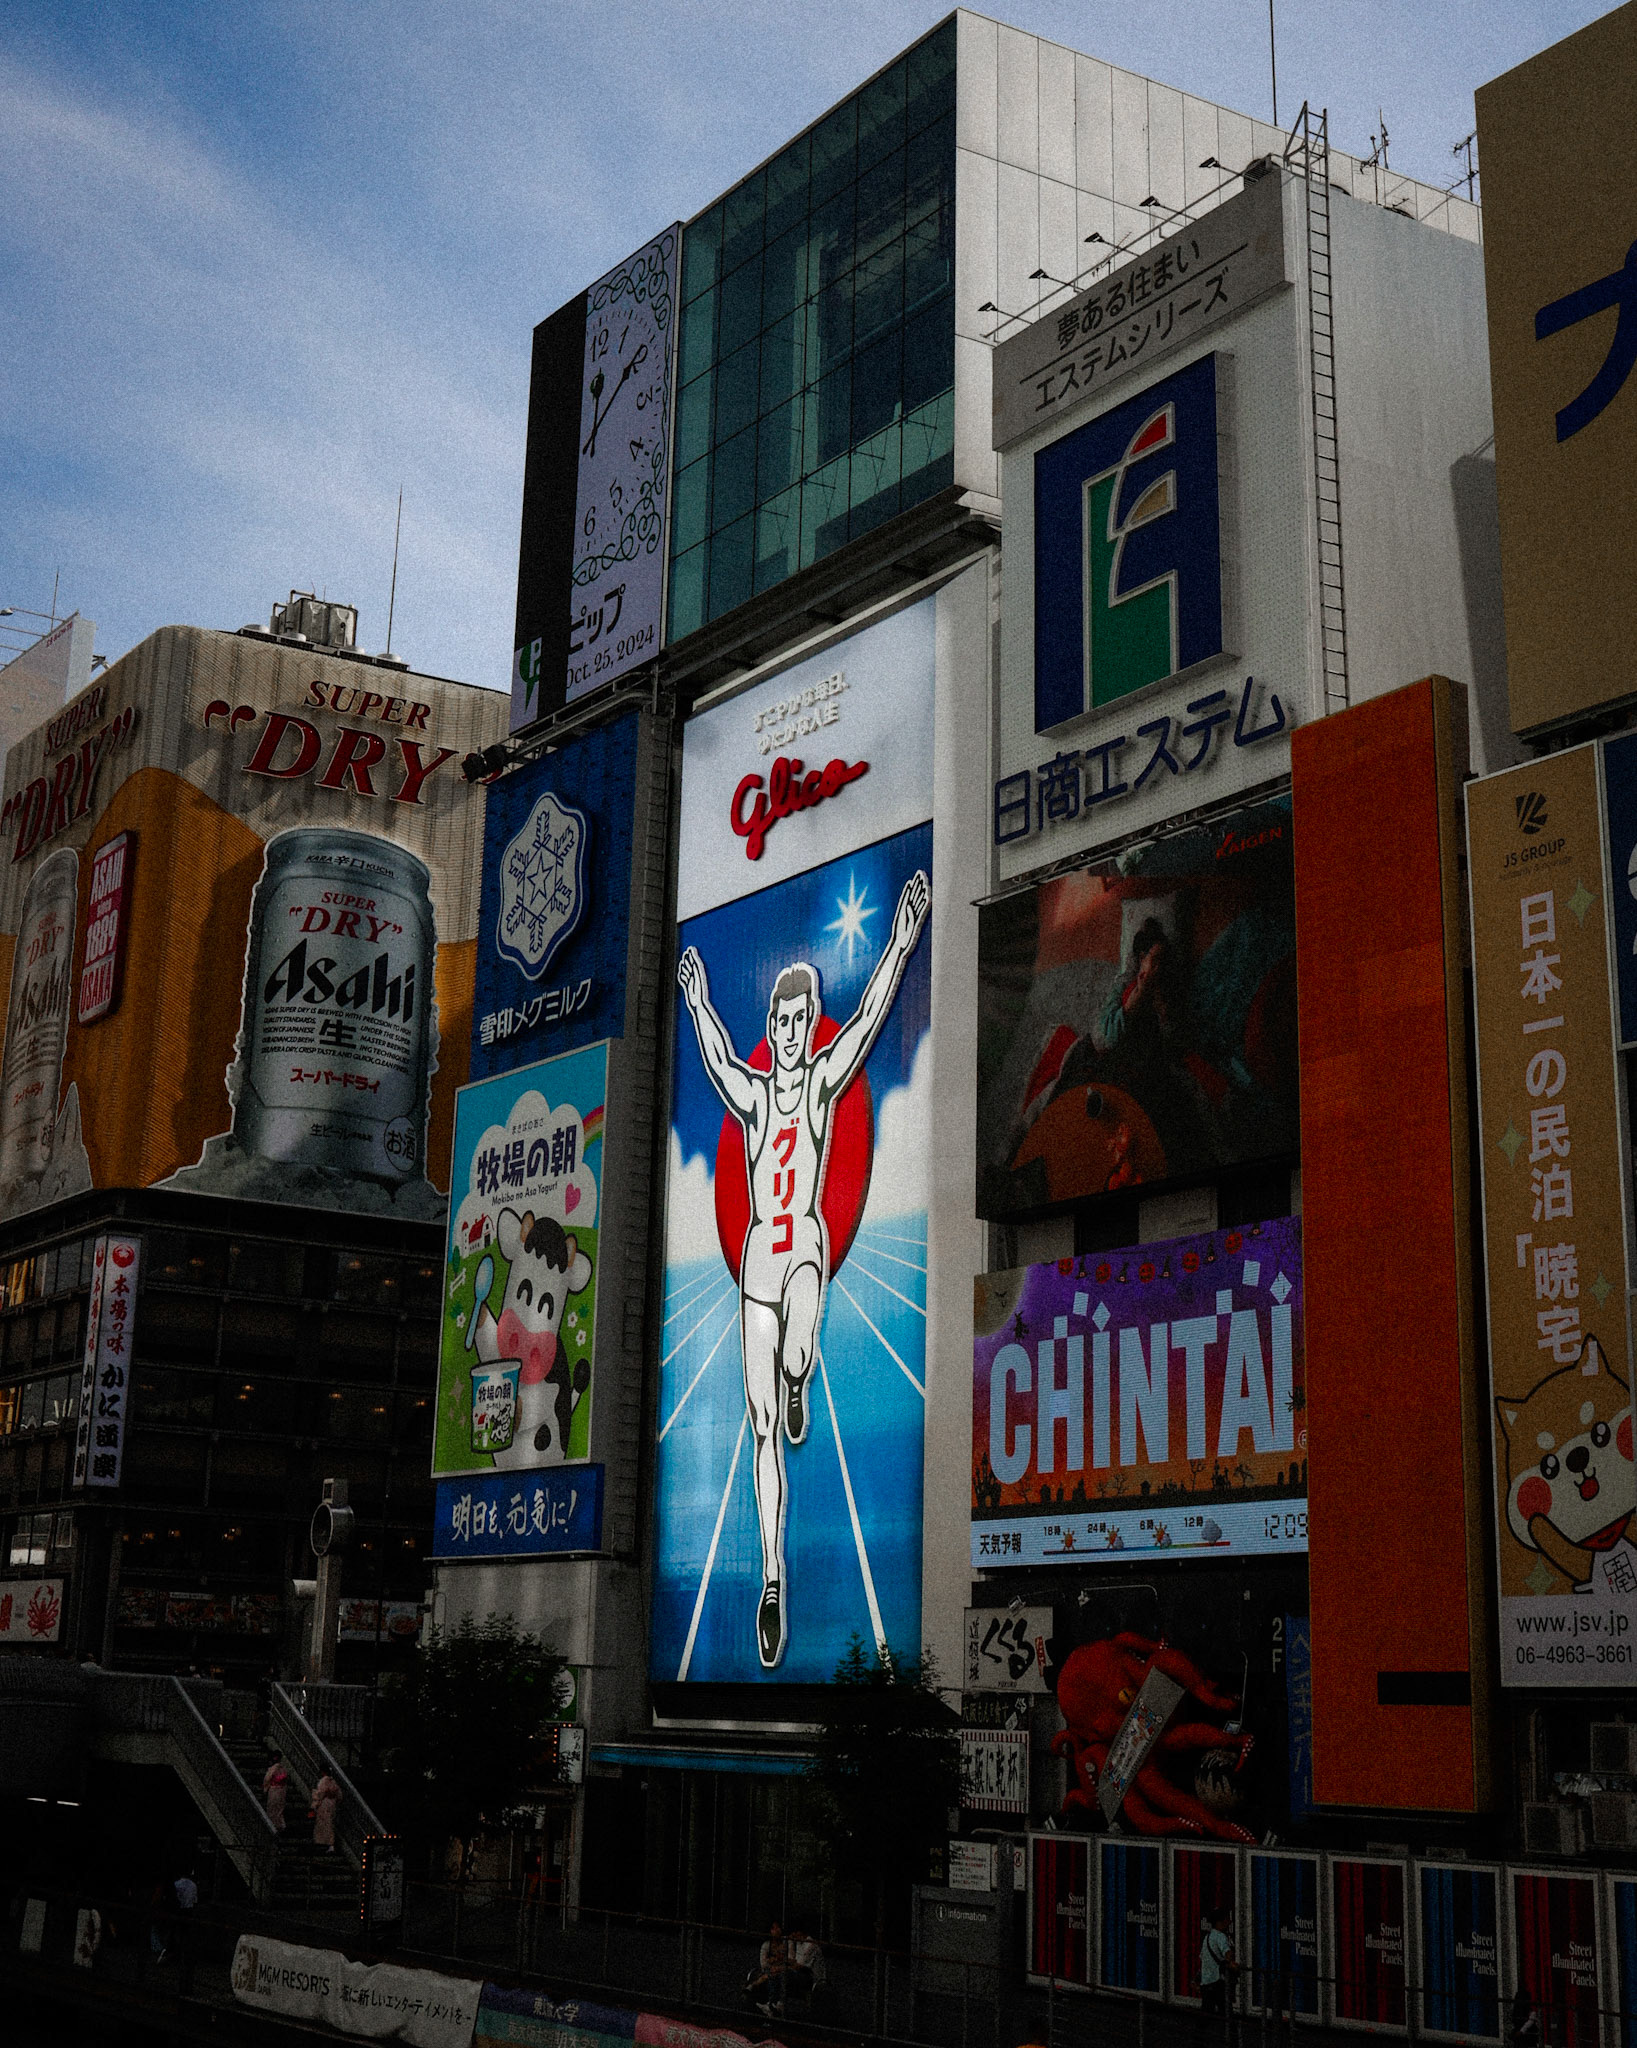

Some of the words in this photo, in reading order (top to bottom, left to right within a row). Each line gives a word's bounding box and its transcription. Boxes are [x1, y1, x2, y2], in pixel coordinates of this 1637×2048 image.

[1057, 239, 1200, 350] 夢ある住まい
[1035, 266, 1230, 412] エステムシリーズ
[594, 649, 614, 686] 25,
[616, 624, 656, 661] 2024
[44, 687, 103, 757] SUPER
[304, 681, 431, 730] SUPER
[994, 676, 1285, 846] 日商エステム
[731, 757, 869, 860] Glico
[366, 863, 395, 877] KUCHI
[1504, 852, 1518, 868] JS
[1521, 838, 1565, 862] GROUP
[321, 892, 376, 912] SUPER
[264, 938, 415, 1021] Asahi
[479, 978, 592, 1046] 雪印メグミルク
[319, 1019, 357, 1049] 生
[290, 1068, 380, 1094] スーパードライ
[309, 1123, 348, 1140] 生ビール
[387, 1127, 415, 1161] お酒
[477, 1124, 577, 1197] 牧場の朝
[772, 1117, 800, 1255] グリコ
[107, 1273, 130, 1355] 本場の味
[478, 1382, 512, 1402] 牧場の朝
[989, 1260, 1295, 1486] CHINTAI
[979, 1534, 1022, 1555] 天気予報
[1516, 1610, 1629, 1637] www.jsv.jp
[980, 1617, 1035, 1680] くくる
[1516, 1644, 1634, 1665] 06-4963-3661
[1471, 1931, 1493, 1946] Street
[1568, 1940, 1592, 1957] Street
[258, 1963, 280, 1986] MGM
[281, 1969, 330, 1996] RESORTS
